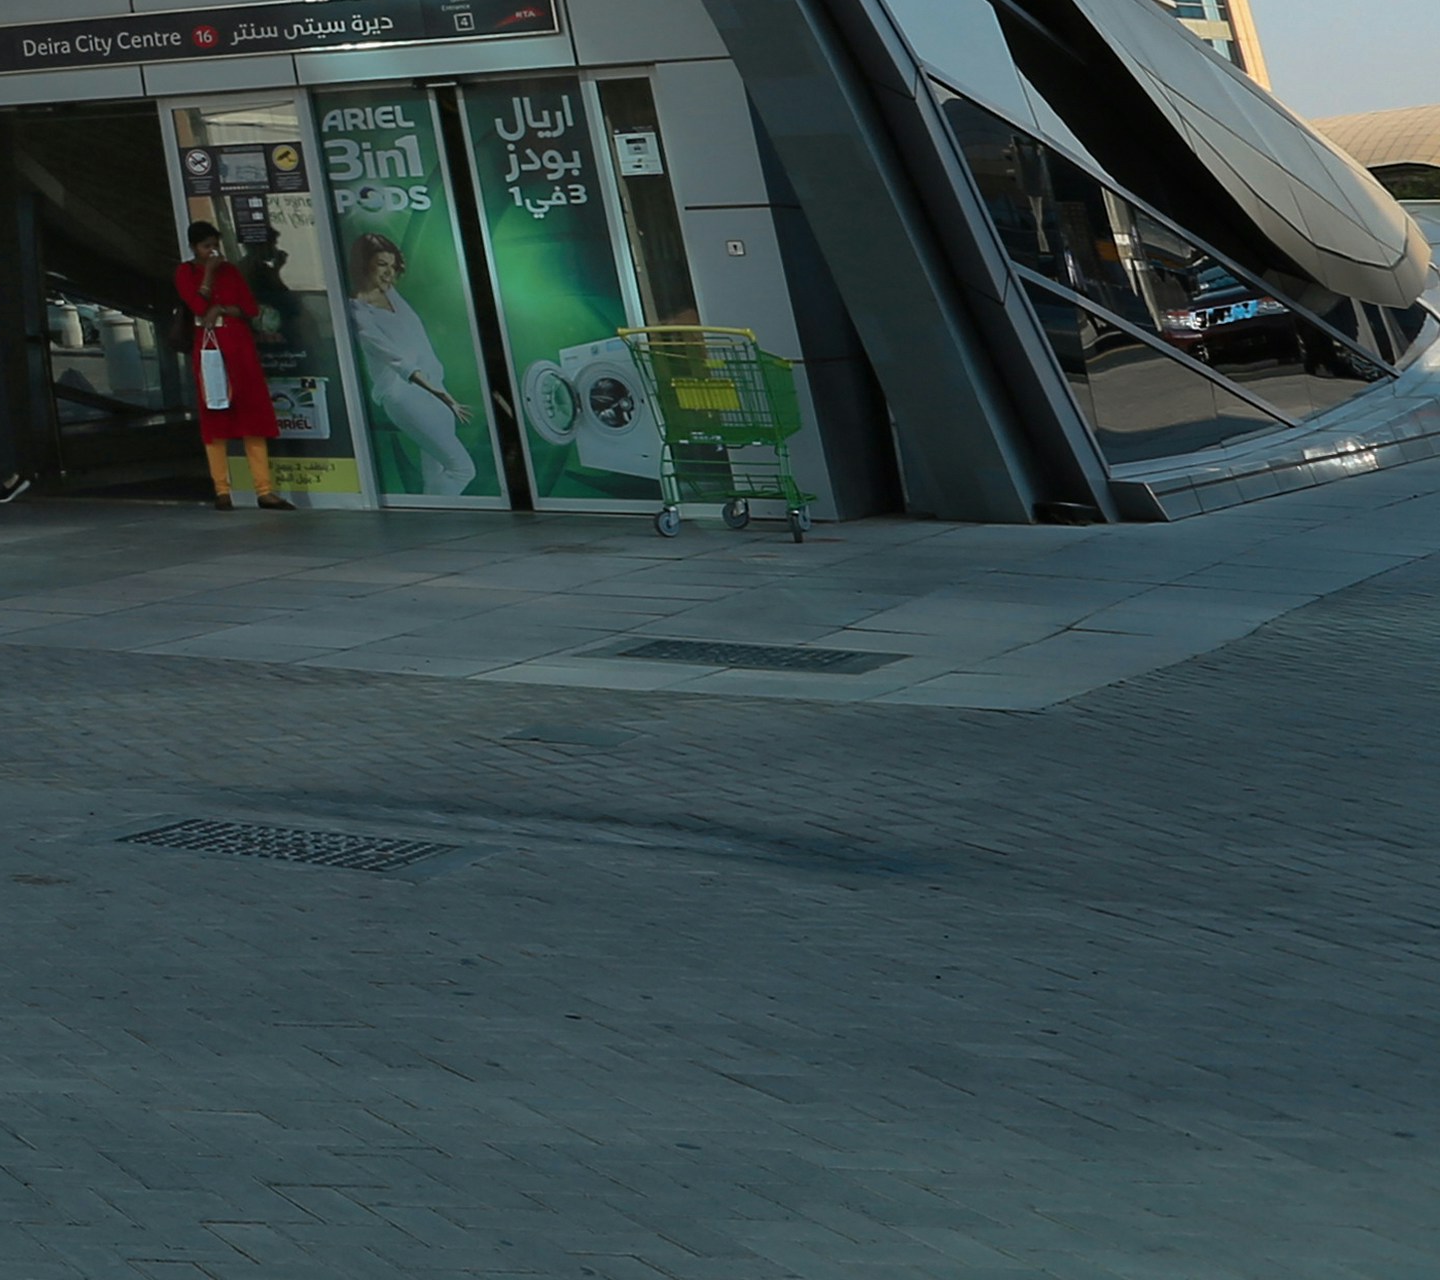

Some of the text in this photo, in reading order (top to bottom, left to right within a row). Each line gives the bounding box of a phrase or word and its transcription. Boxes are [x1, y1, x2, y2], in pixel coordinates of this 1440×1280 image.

[230, 23, 279, 46] سنتر
[350, 13, 394, 35] ديرة
[22, 29, 213, 57] Deira City Centre 16
[321, 105, 415, 132] ARIEL
[505, 143, 582, 182] بودز
